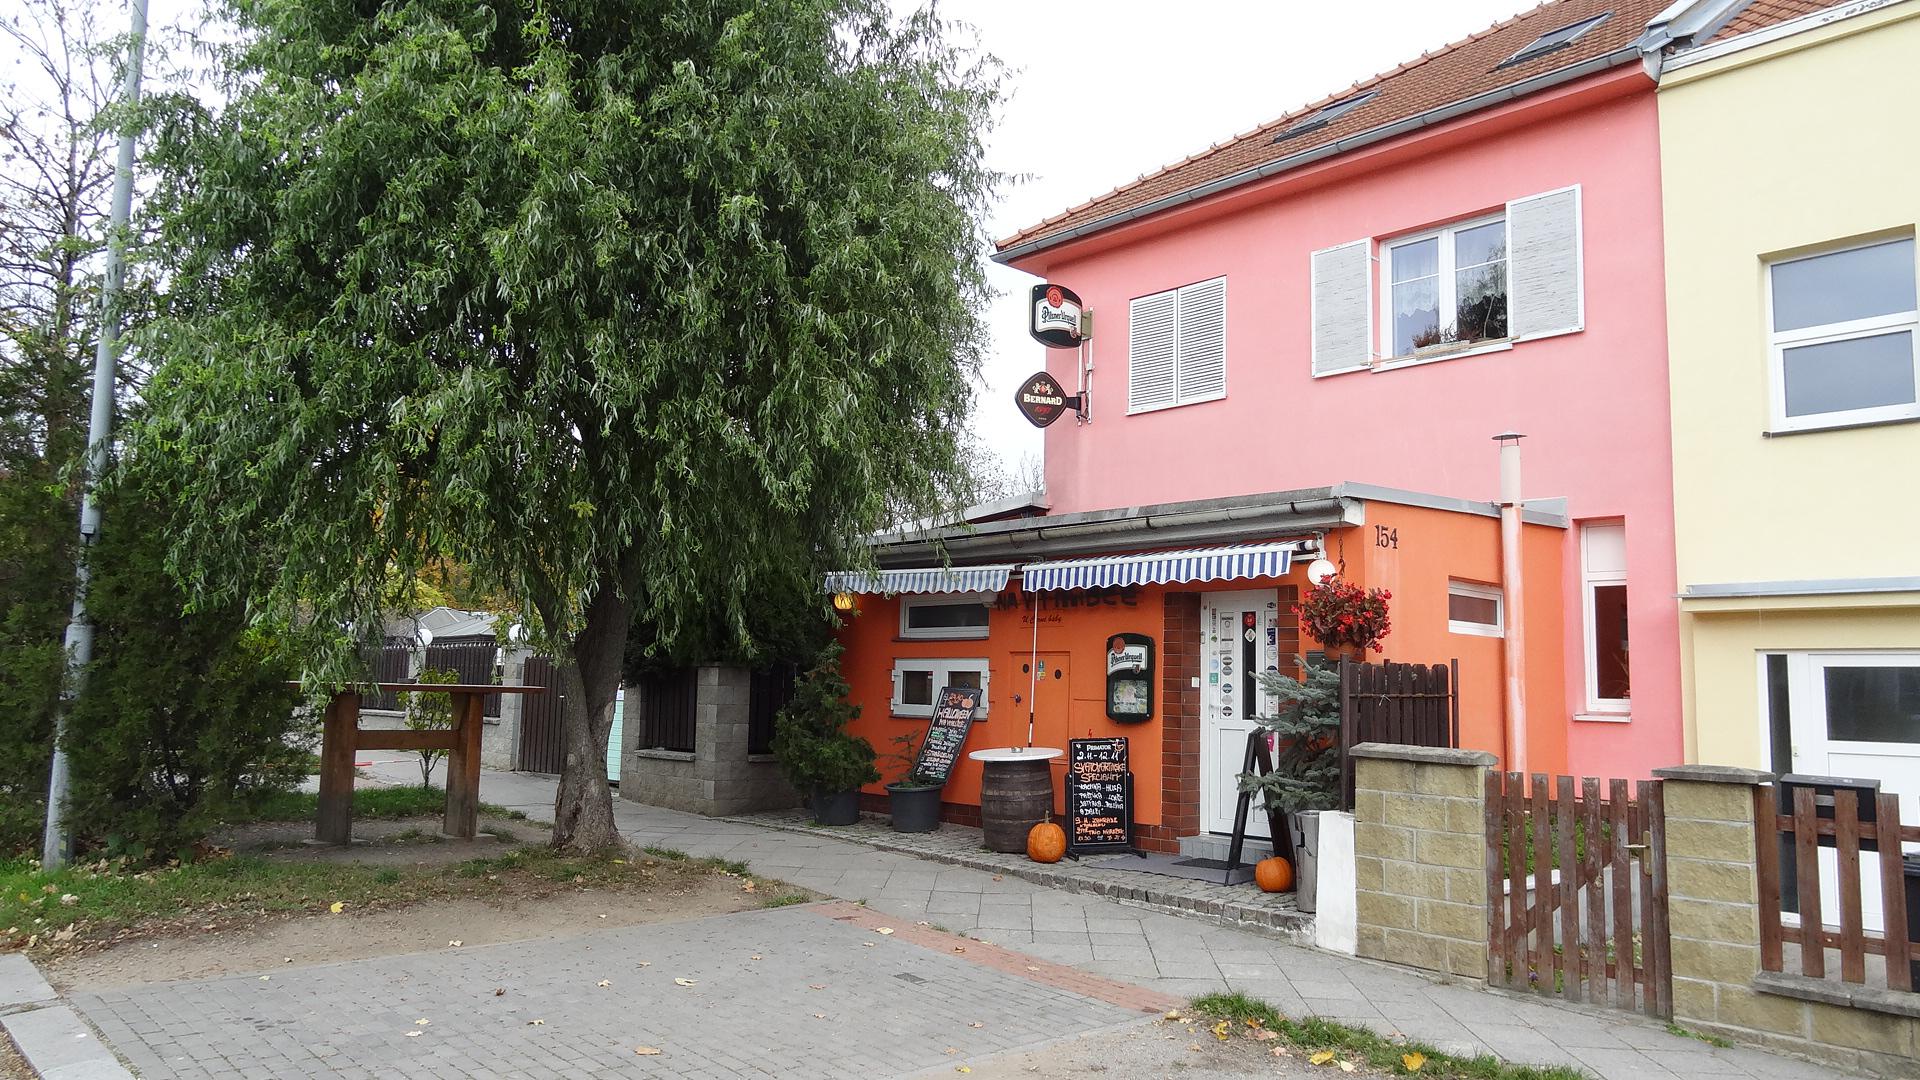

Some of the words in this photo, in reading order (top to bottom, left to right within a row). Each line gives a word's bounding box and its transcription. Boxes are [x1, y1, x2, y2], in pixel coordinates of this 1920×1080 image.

[1041, 306, 1061, 323] Pilsner
[1023, 393, 1063, 406] BERNARD
[1374, 524, 1398, 549] 154
